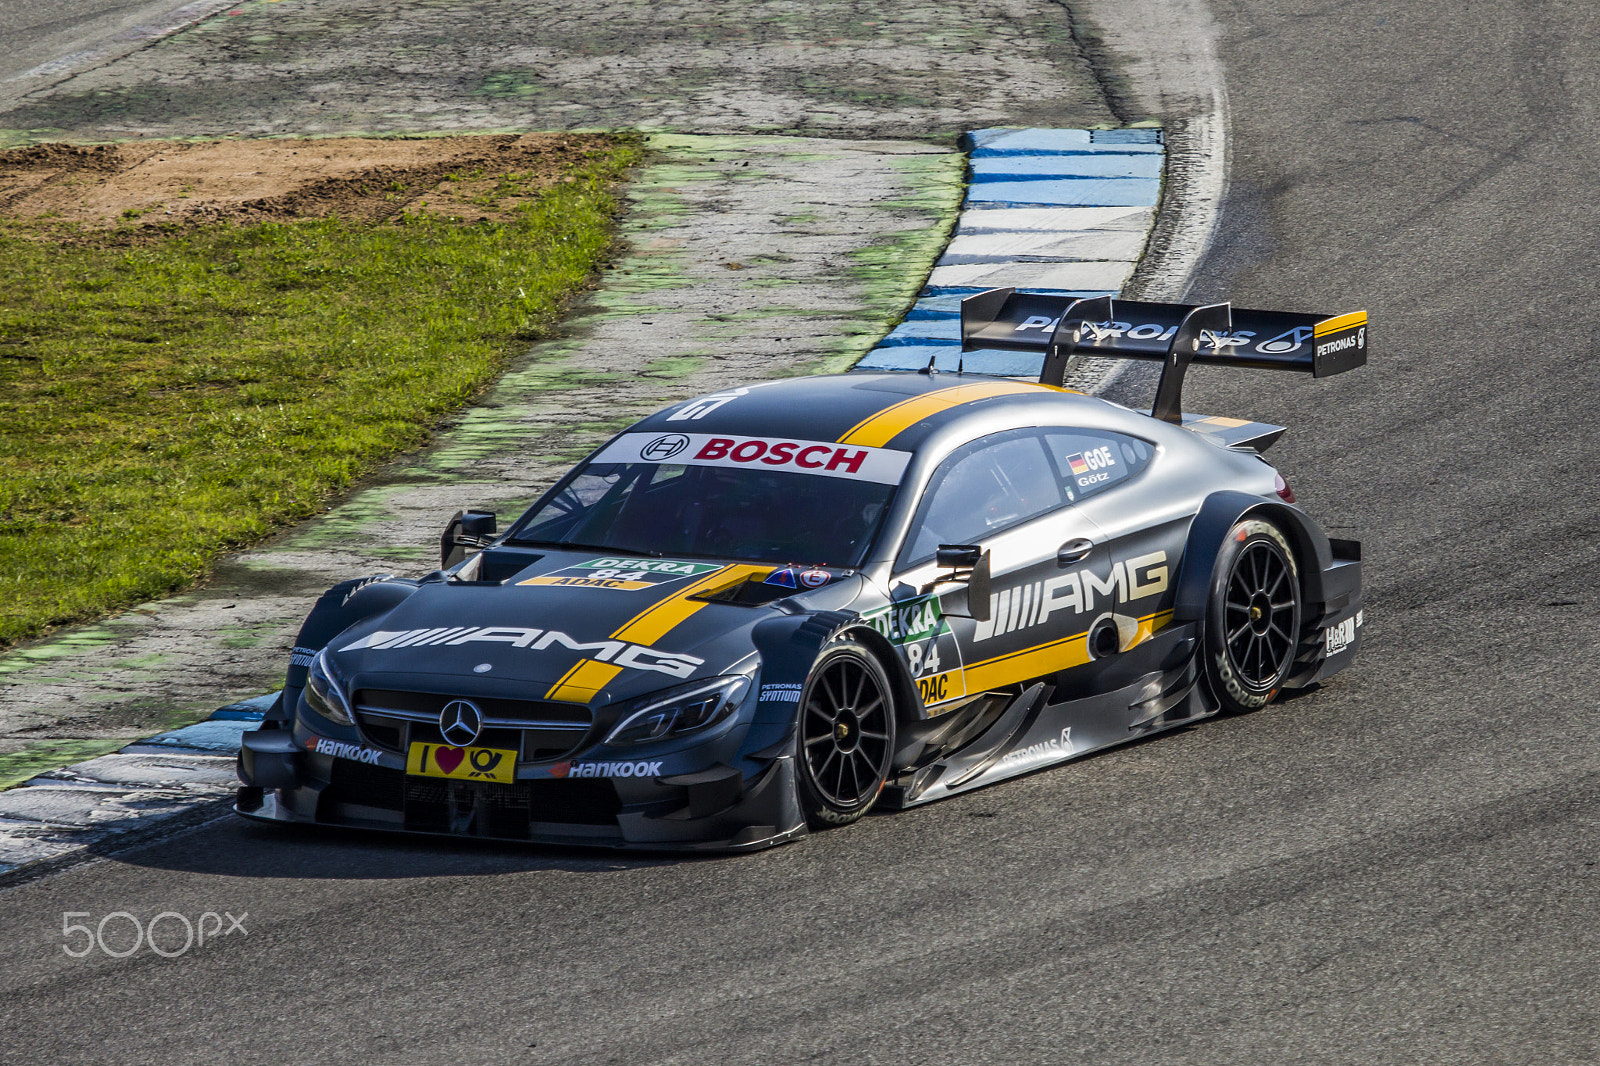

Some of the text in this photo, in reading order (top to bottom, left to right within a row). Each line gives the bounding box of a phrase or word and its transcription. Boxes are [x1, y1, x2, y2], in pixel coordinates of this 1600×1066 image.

[1316, 336, 1356, 357] PETRONAS
[693, 438, 869, 473] BOSCH
[1083, 446, 1115, 471] GOE
[1078, 472, 1110, 487] Götz
[588, 568, 648, 581] 84
[591, 559, 695, 574] DEKRA
[551, 577, 625, 588] ADAC
[875, 601, 937, 640] DEKRA
[908, 643, 940, 678] 84
[919, 674, 948, 703] DAC
